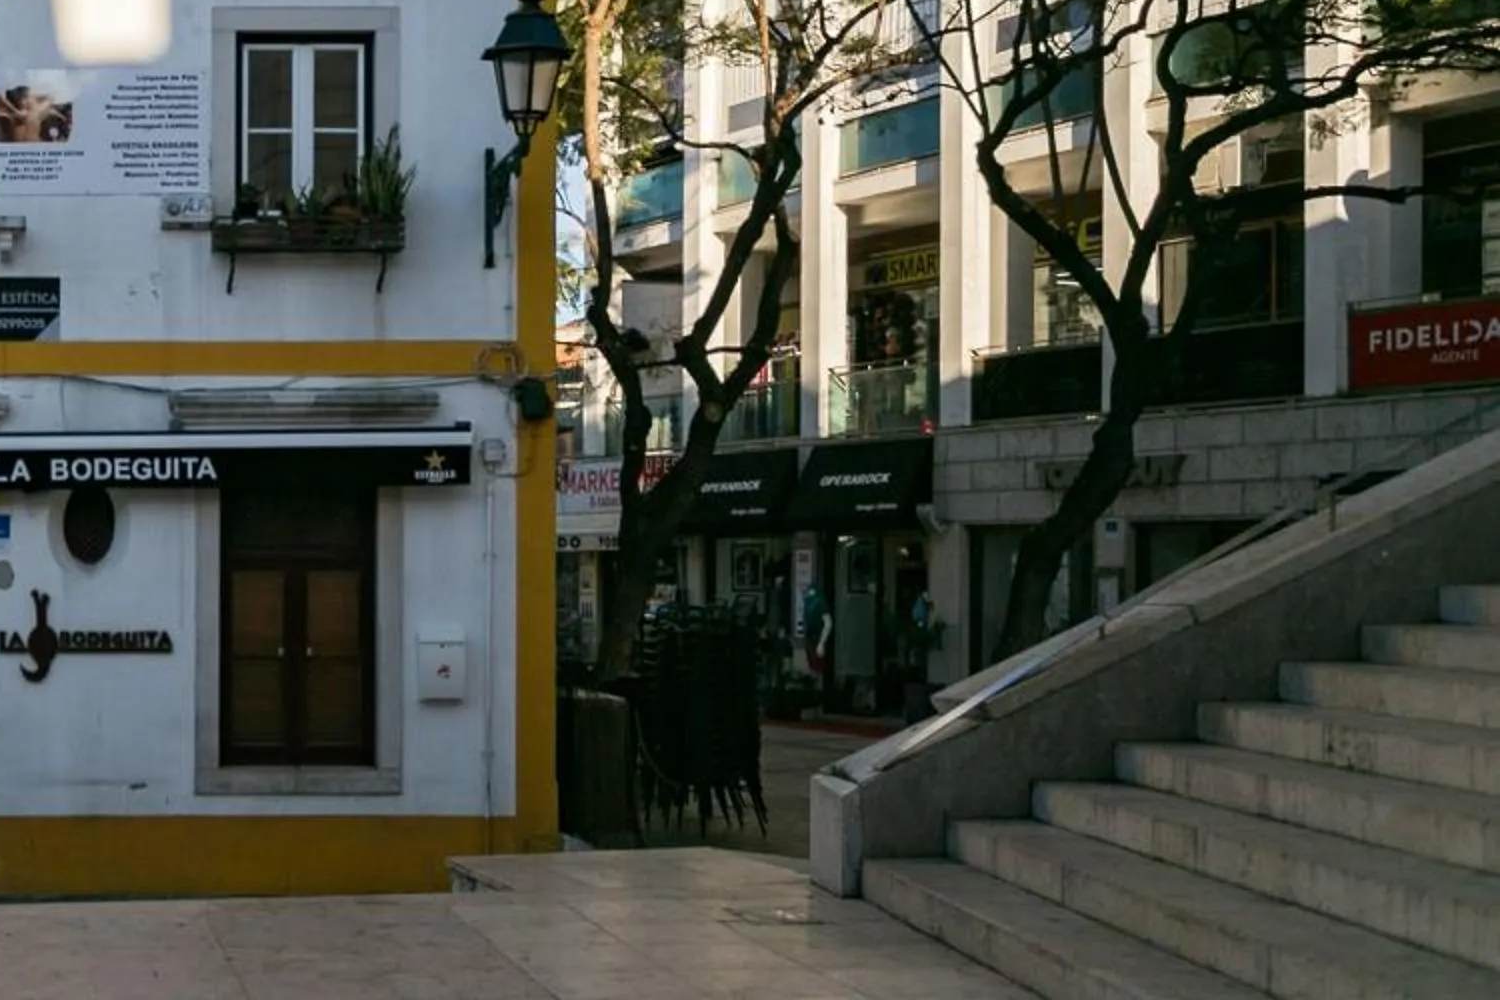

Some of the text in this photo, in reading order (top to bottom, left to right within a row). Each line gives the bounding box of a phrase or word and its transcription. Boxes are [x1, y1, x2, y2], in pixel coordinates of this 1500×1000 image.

[888, 251, 938, 281] SMAR
[1431, 348, 1480, 364] AGENTE
[51, 457, 217, 481] BODEGUITA
[561, 463, 621, 493] MARKE
[58, 629, 174, 652] BODEGUITA
